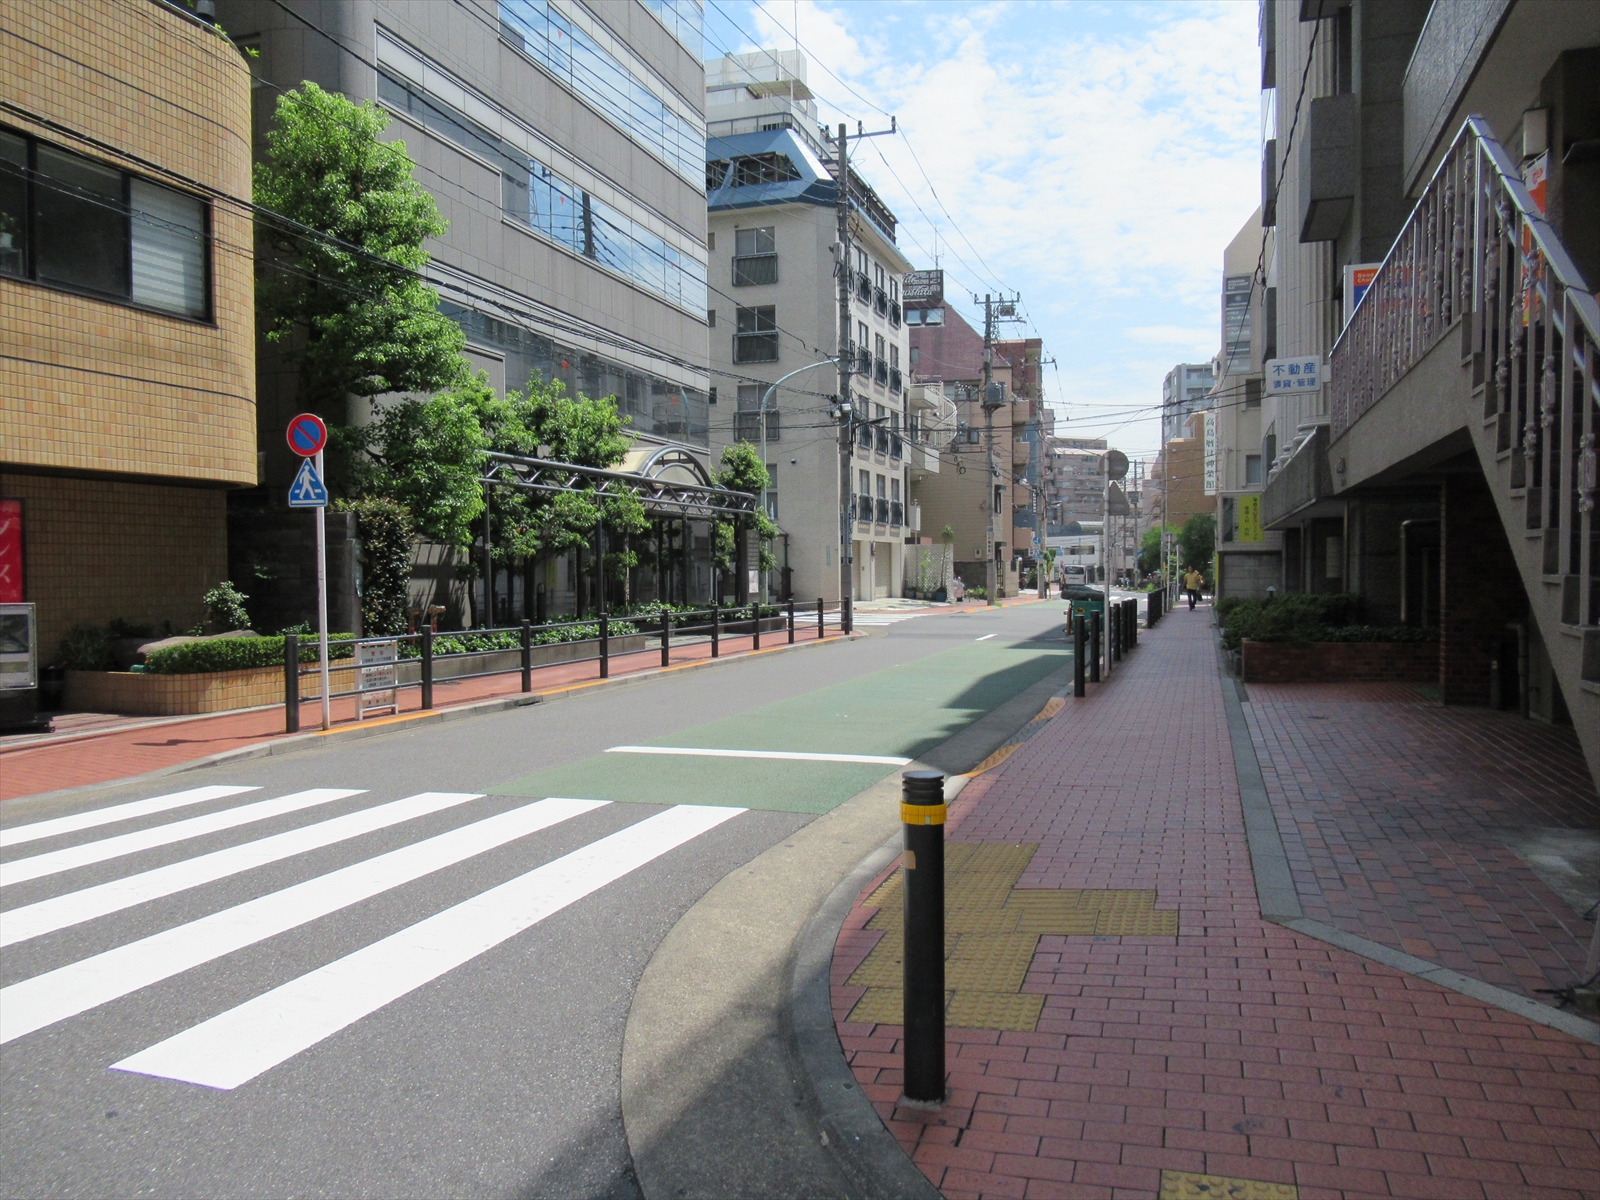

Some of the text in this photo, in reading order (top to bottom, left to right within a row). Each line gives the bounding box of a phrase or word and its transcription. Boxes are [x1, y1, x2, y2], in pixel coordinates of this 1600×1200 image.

[1272, 362, 1316, 377] 不動産
[1273, 377, 1316, 389] 賃貸・管理
